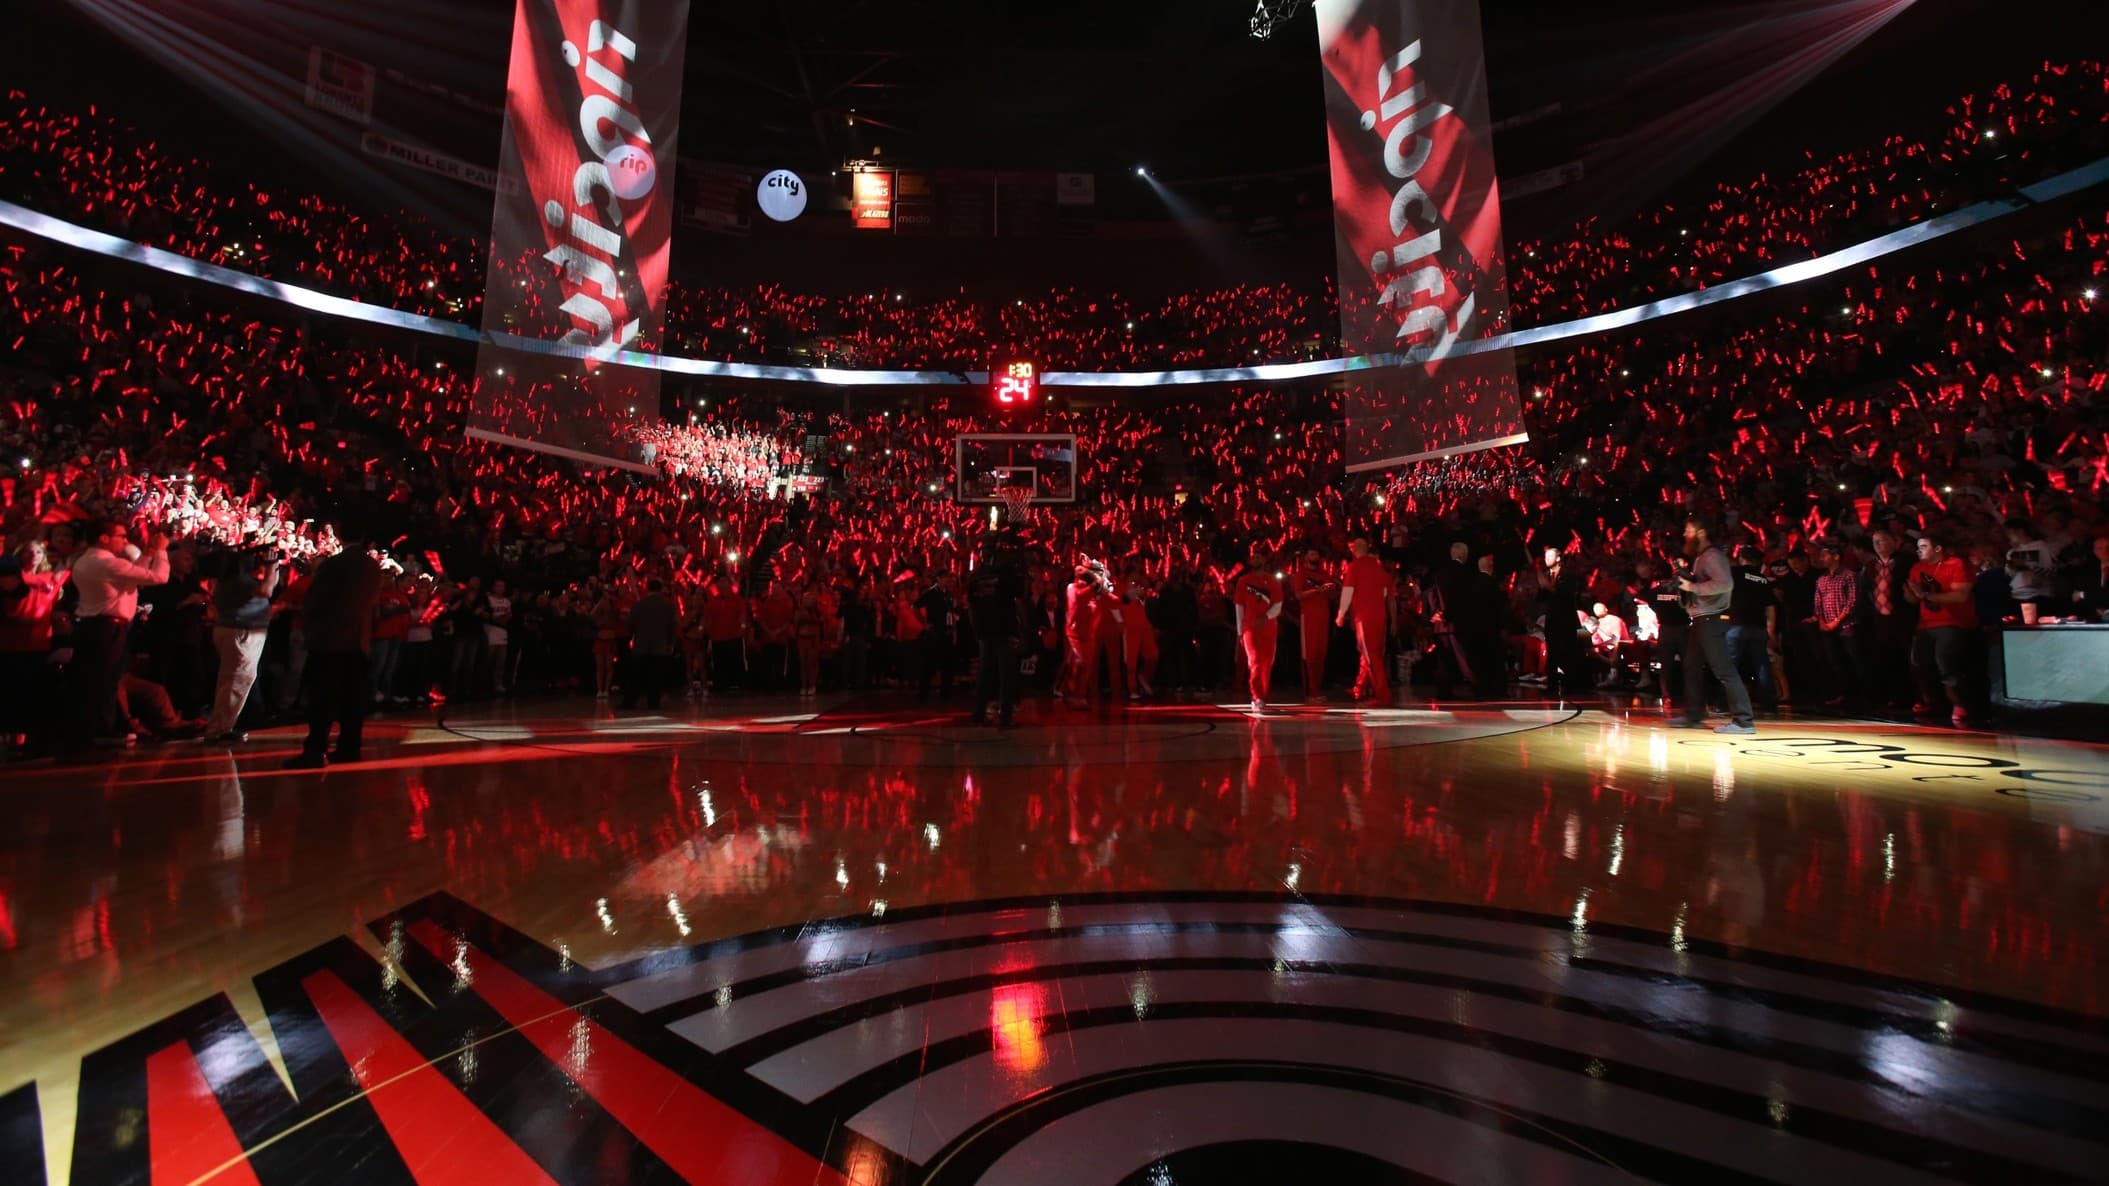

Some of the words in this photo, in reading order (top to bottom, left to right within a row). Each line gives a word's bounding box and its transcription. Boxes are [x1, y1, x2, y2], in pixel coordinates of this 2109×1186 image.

[389, 145, 459, 177] MILLER
[619, 155, 650, 173] rip
[768, 174, 799, 196] city
[1000, 378, 1029, 402] 24
